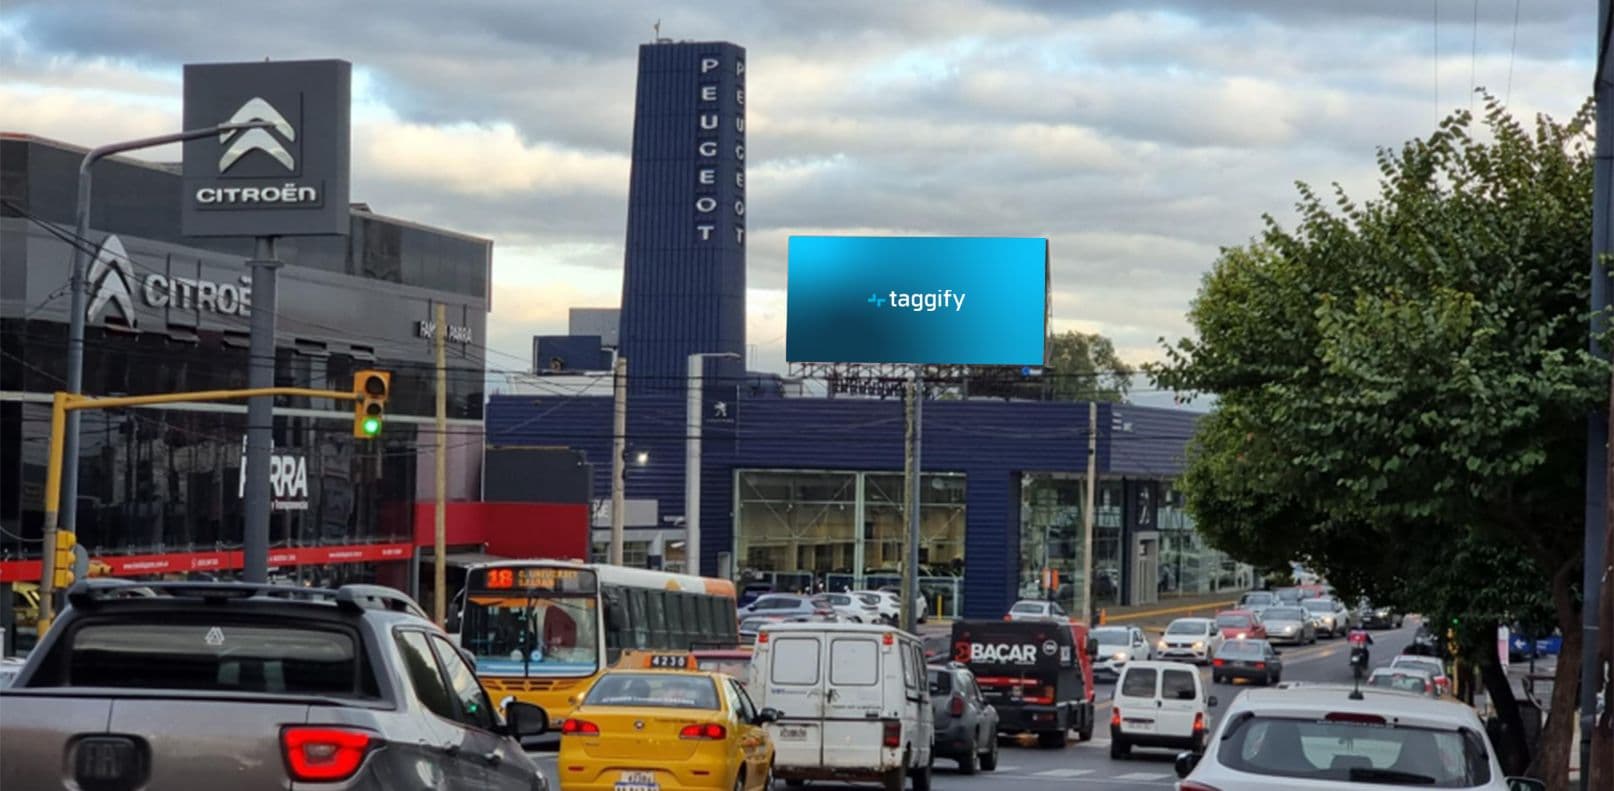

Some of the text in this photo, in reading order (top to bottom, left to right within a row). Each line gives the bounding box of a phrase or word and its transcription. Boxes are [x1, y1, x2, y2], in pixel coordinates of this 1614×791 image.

[696, 58, 719, 240] PEUGEOT
[735, 61, 746, 244] PEUGEOT
[145, 274, 252, 316] CITROË
[889, 289, 966, 312] taggify
[486, 568, 513, 590] 18
